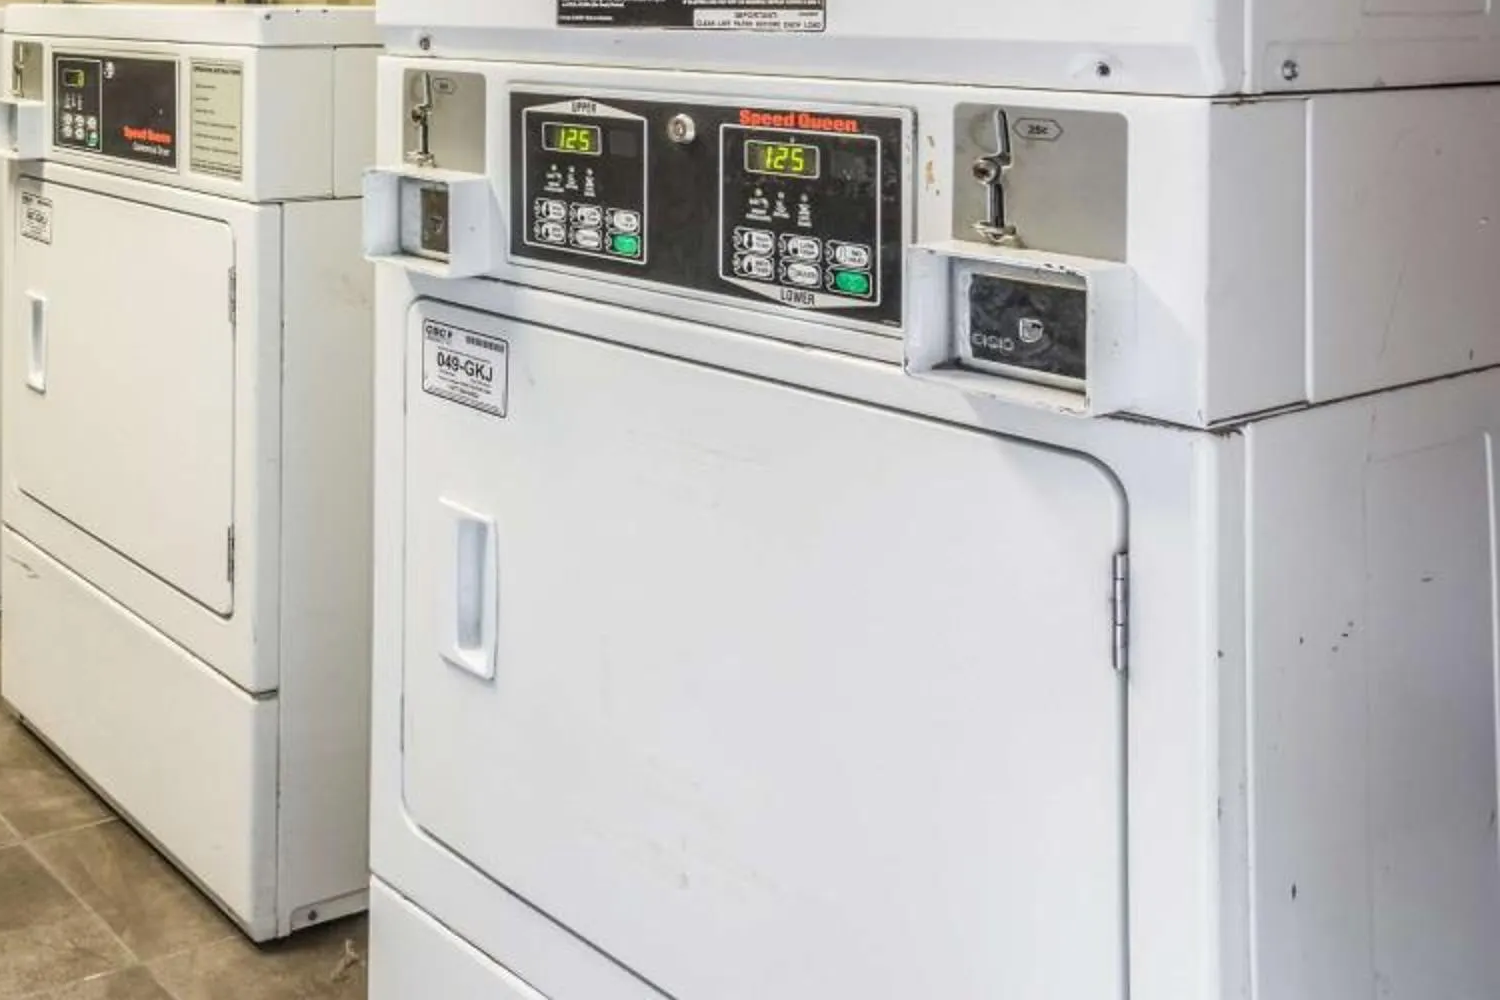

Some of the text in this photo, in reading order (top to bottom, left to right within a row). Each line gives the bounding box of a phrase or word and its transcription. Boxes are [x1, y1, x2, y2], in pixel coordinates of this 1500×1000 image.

[571, 101, 597, 114] UPPER
[739, 108, 858, 132] Speed Queen
[560, 127, 590, 151] 125
[765, 146, 805, 172] 125
[780, 288, 816, 305] LOWER
[437, 351, 493, 382] 049-GKJ
